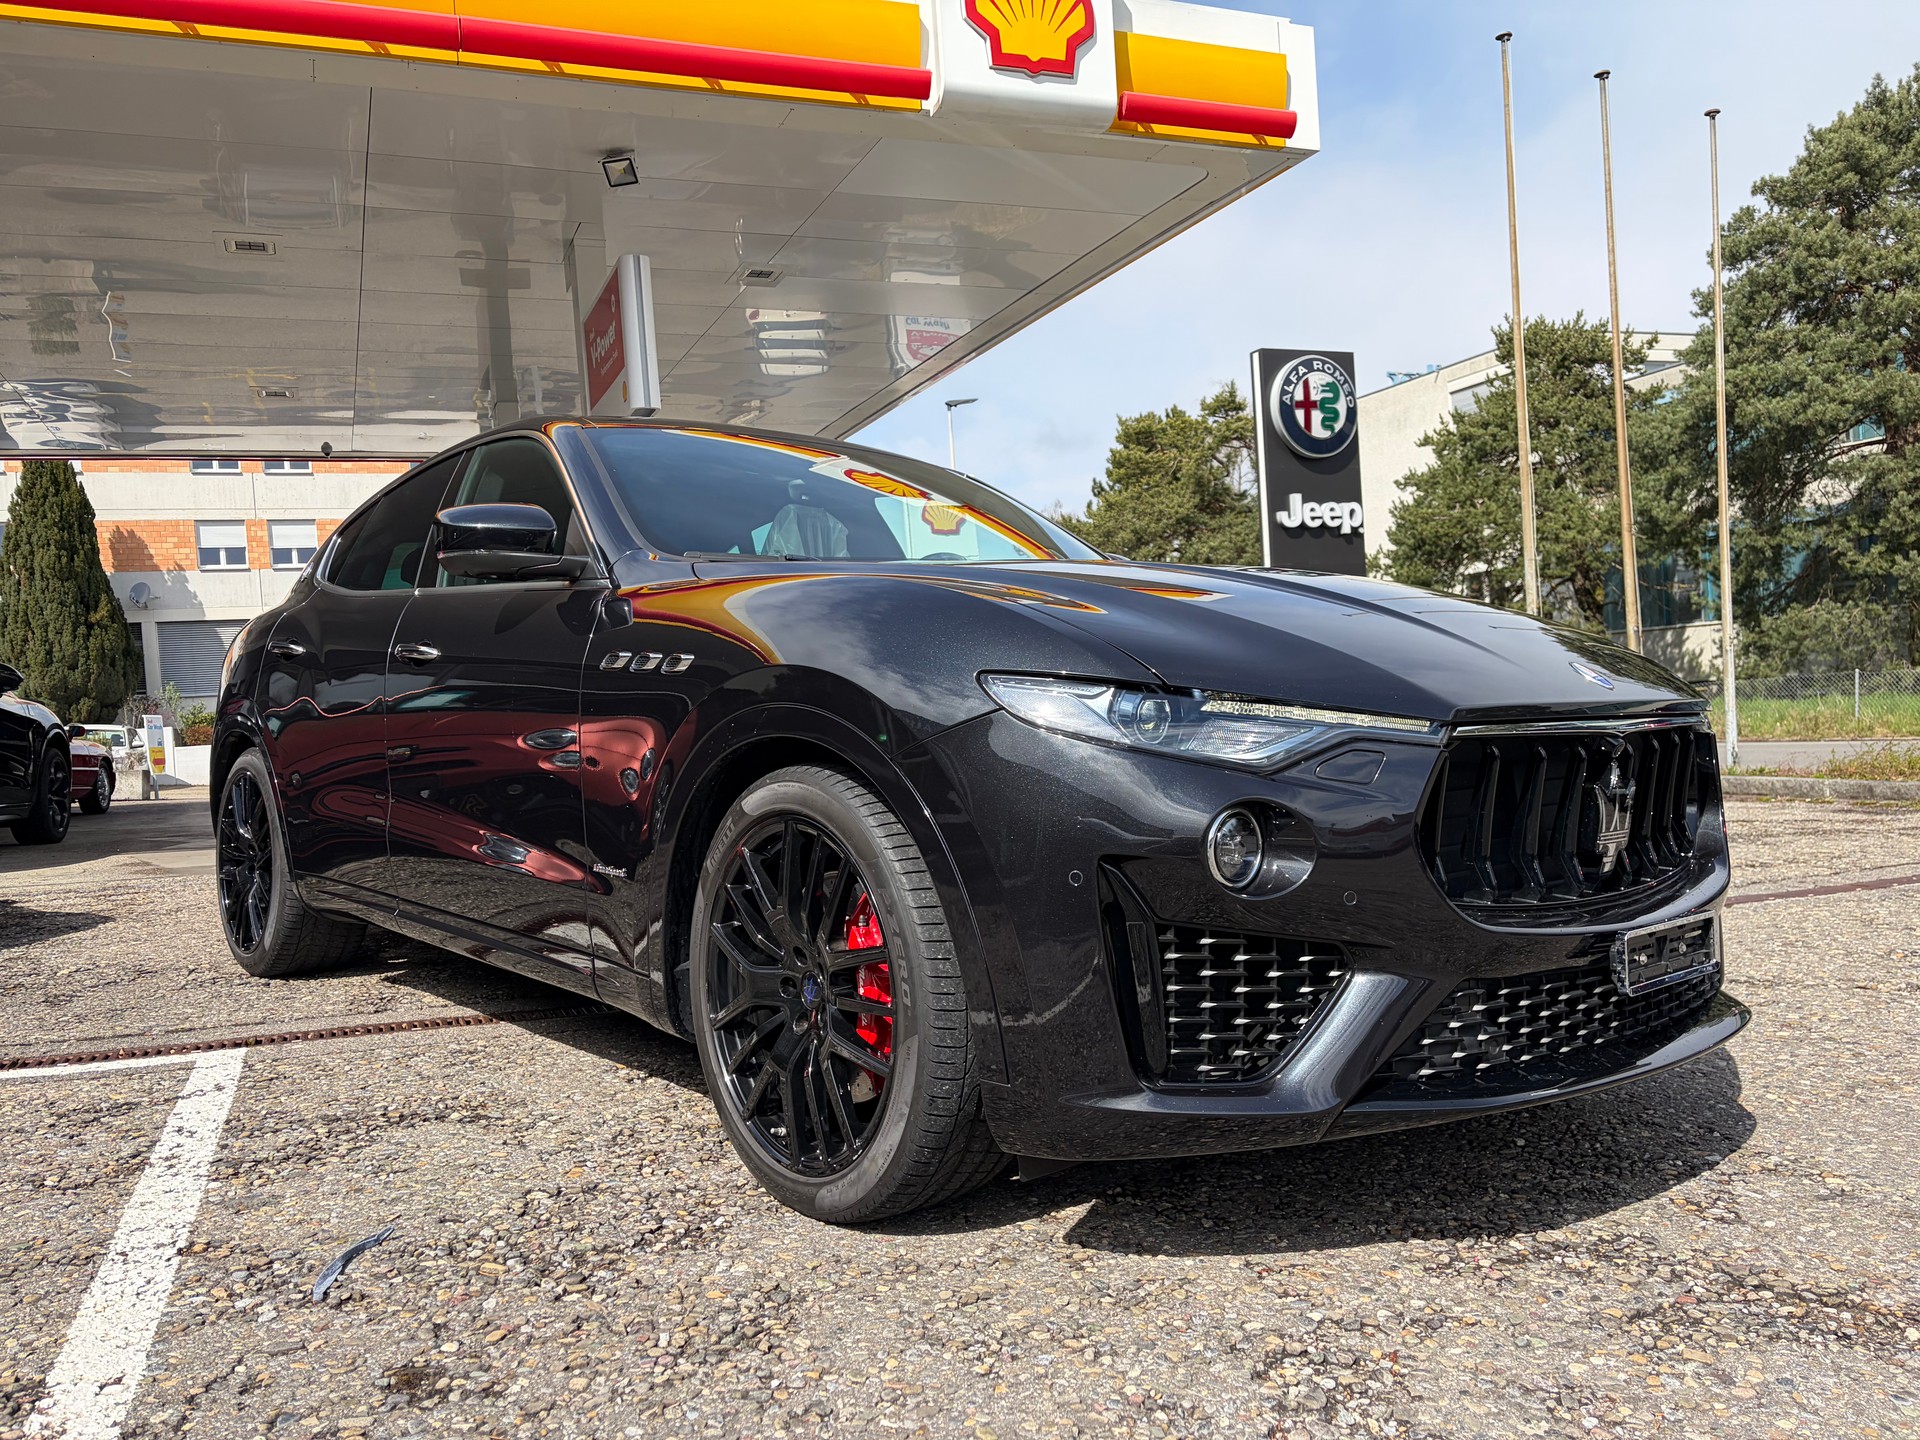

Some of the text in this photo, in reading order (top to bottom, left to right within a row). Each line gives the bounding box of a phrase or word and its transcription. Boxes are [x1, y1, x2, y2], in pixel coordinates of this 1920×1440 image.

[590, 320, 616, 369] V-Power
[1282, 361, 1355, 408] ALFA ROMEO
[706, 816, 736, 874] PIRELLI
[887, 911, 912, 1007] ZERO
